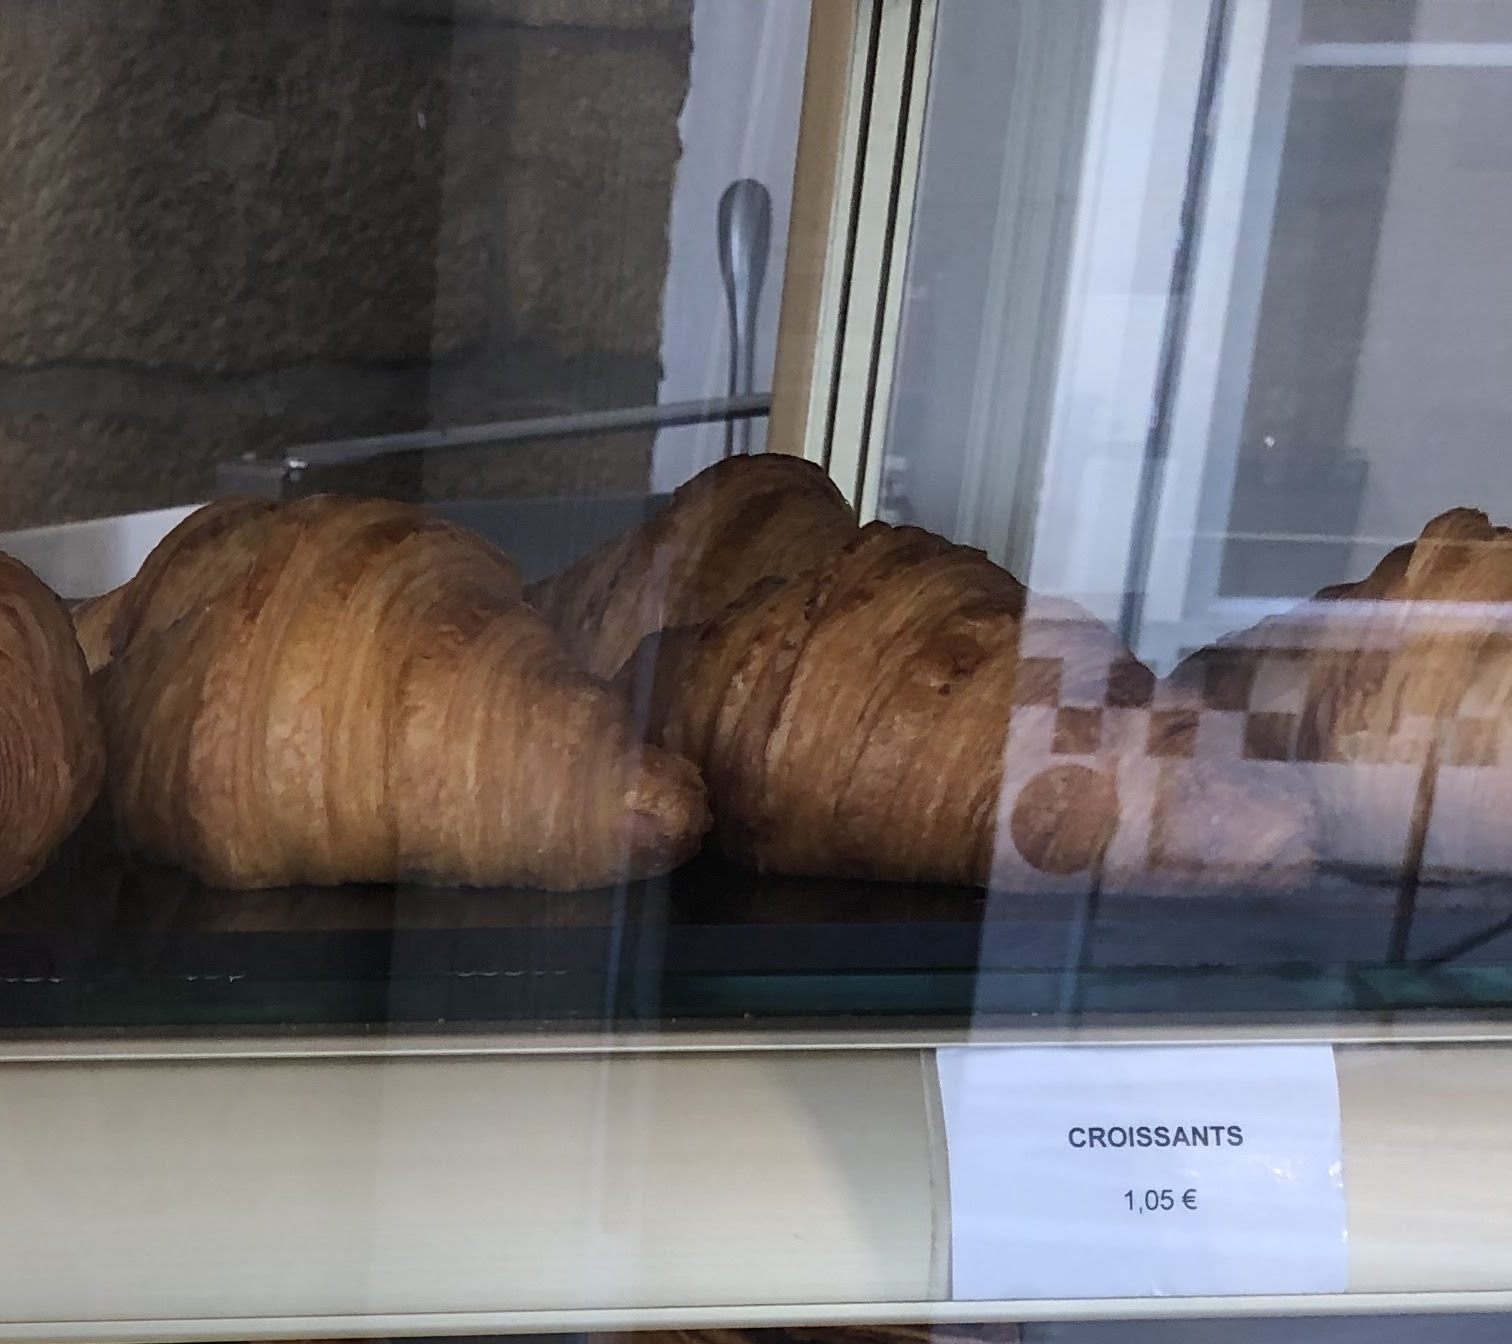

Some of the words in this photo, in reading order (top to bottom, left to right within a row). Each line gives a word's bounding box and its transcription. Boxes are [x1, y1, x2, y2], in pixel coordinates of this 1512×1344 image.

[1068, 1125, 1244, 1148] CROISSANTS
[1124, 1188, 1175, 1215] 1,05
[1181, 1188, 1198, 1211] €
